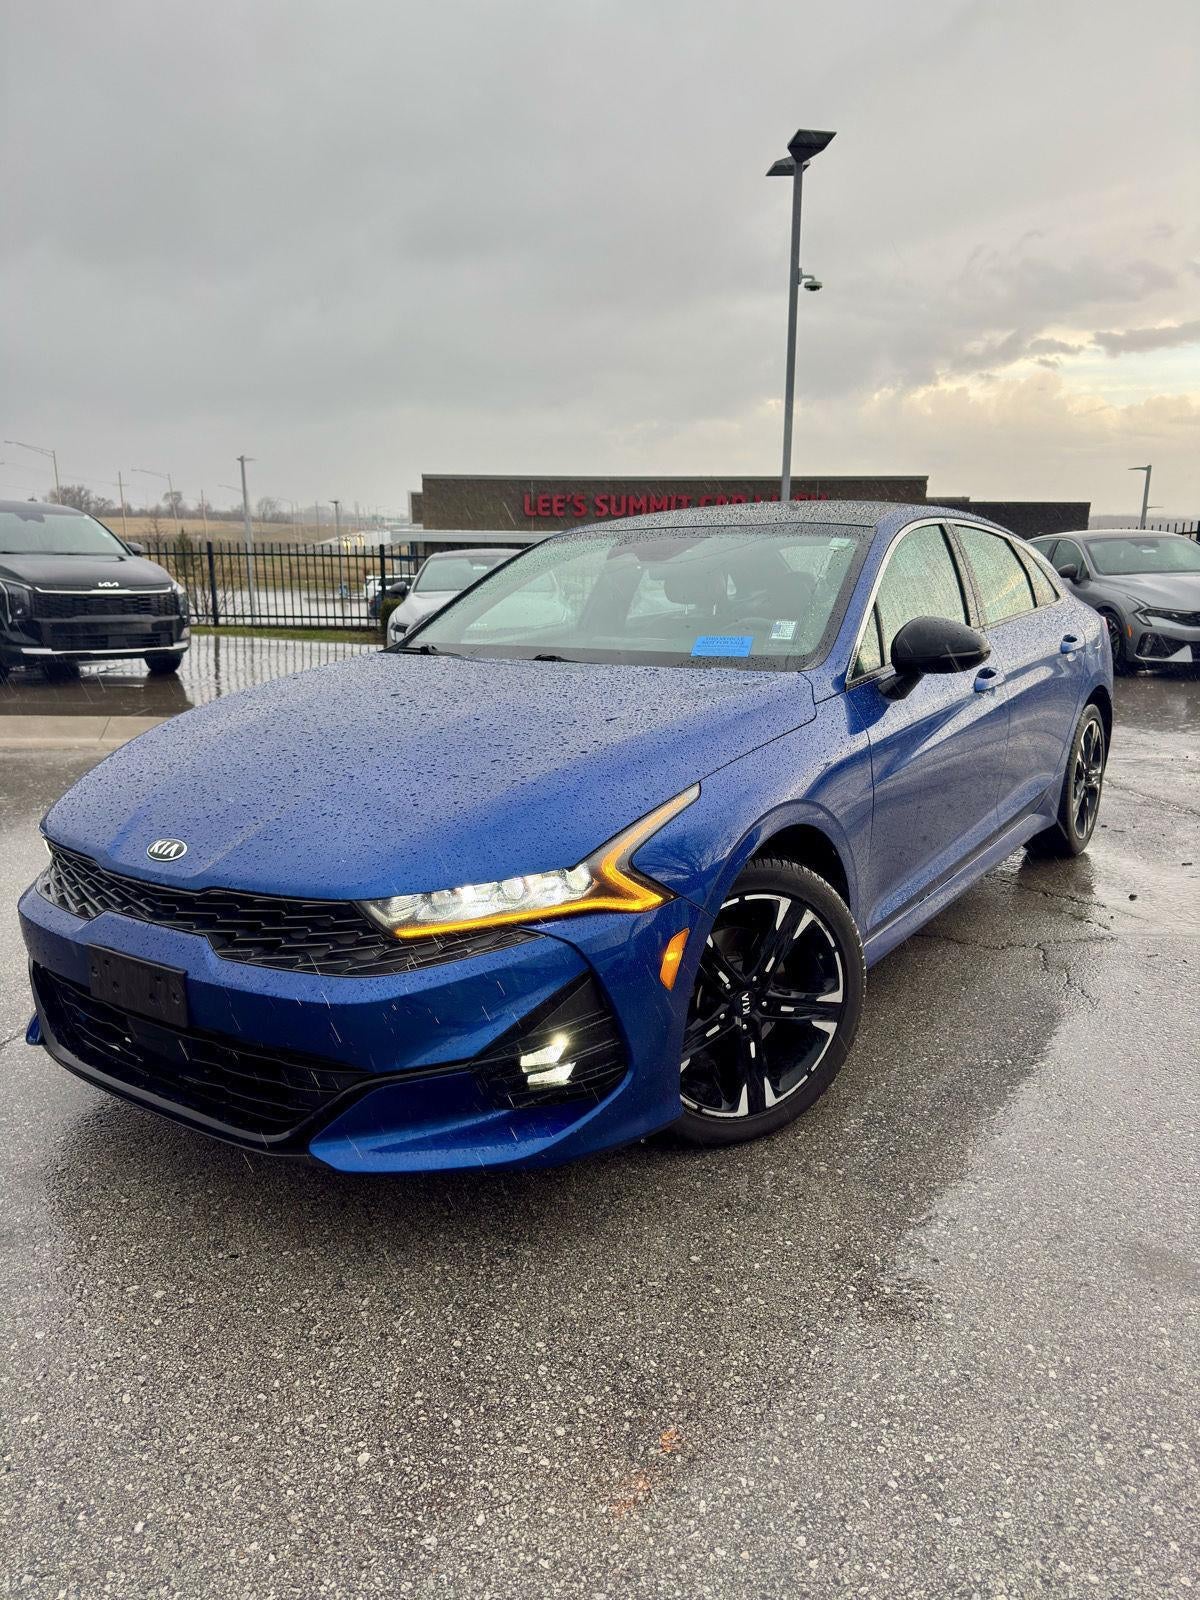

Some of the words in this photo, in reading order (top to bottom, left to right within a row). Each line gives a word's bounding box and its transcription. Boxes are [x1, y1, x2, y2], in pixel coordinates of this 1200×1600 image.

[524, 495, 588, 517] LEE'S
[595, 494, 693, 517] SUMMIT
[149, 840, 180, 857] KIA
[741, 992, 751, 1015] KIA
